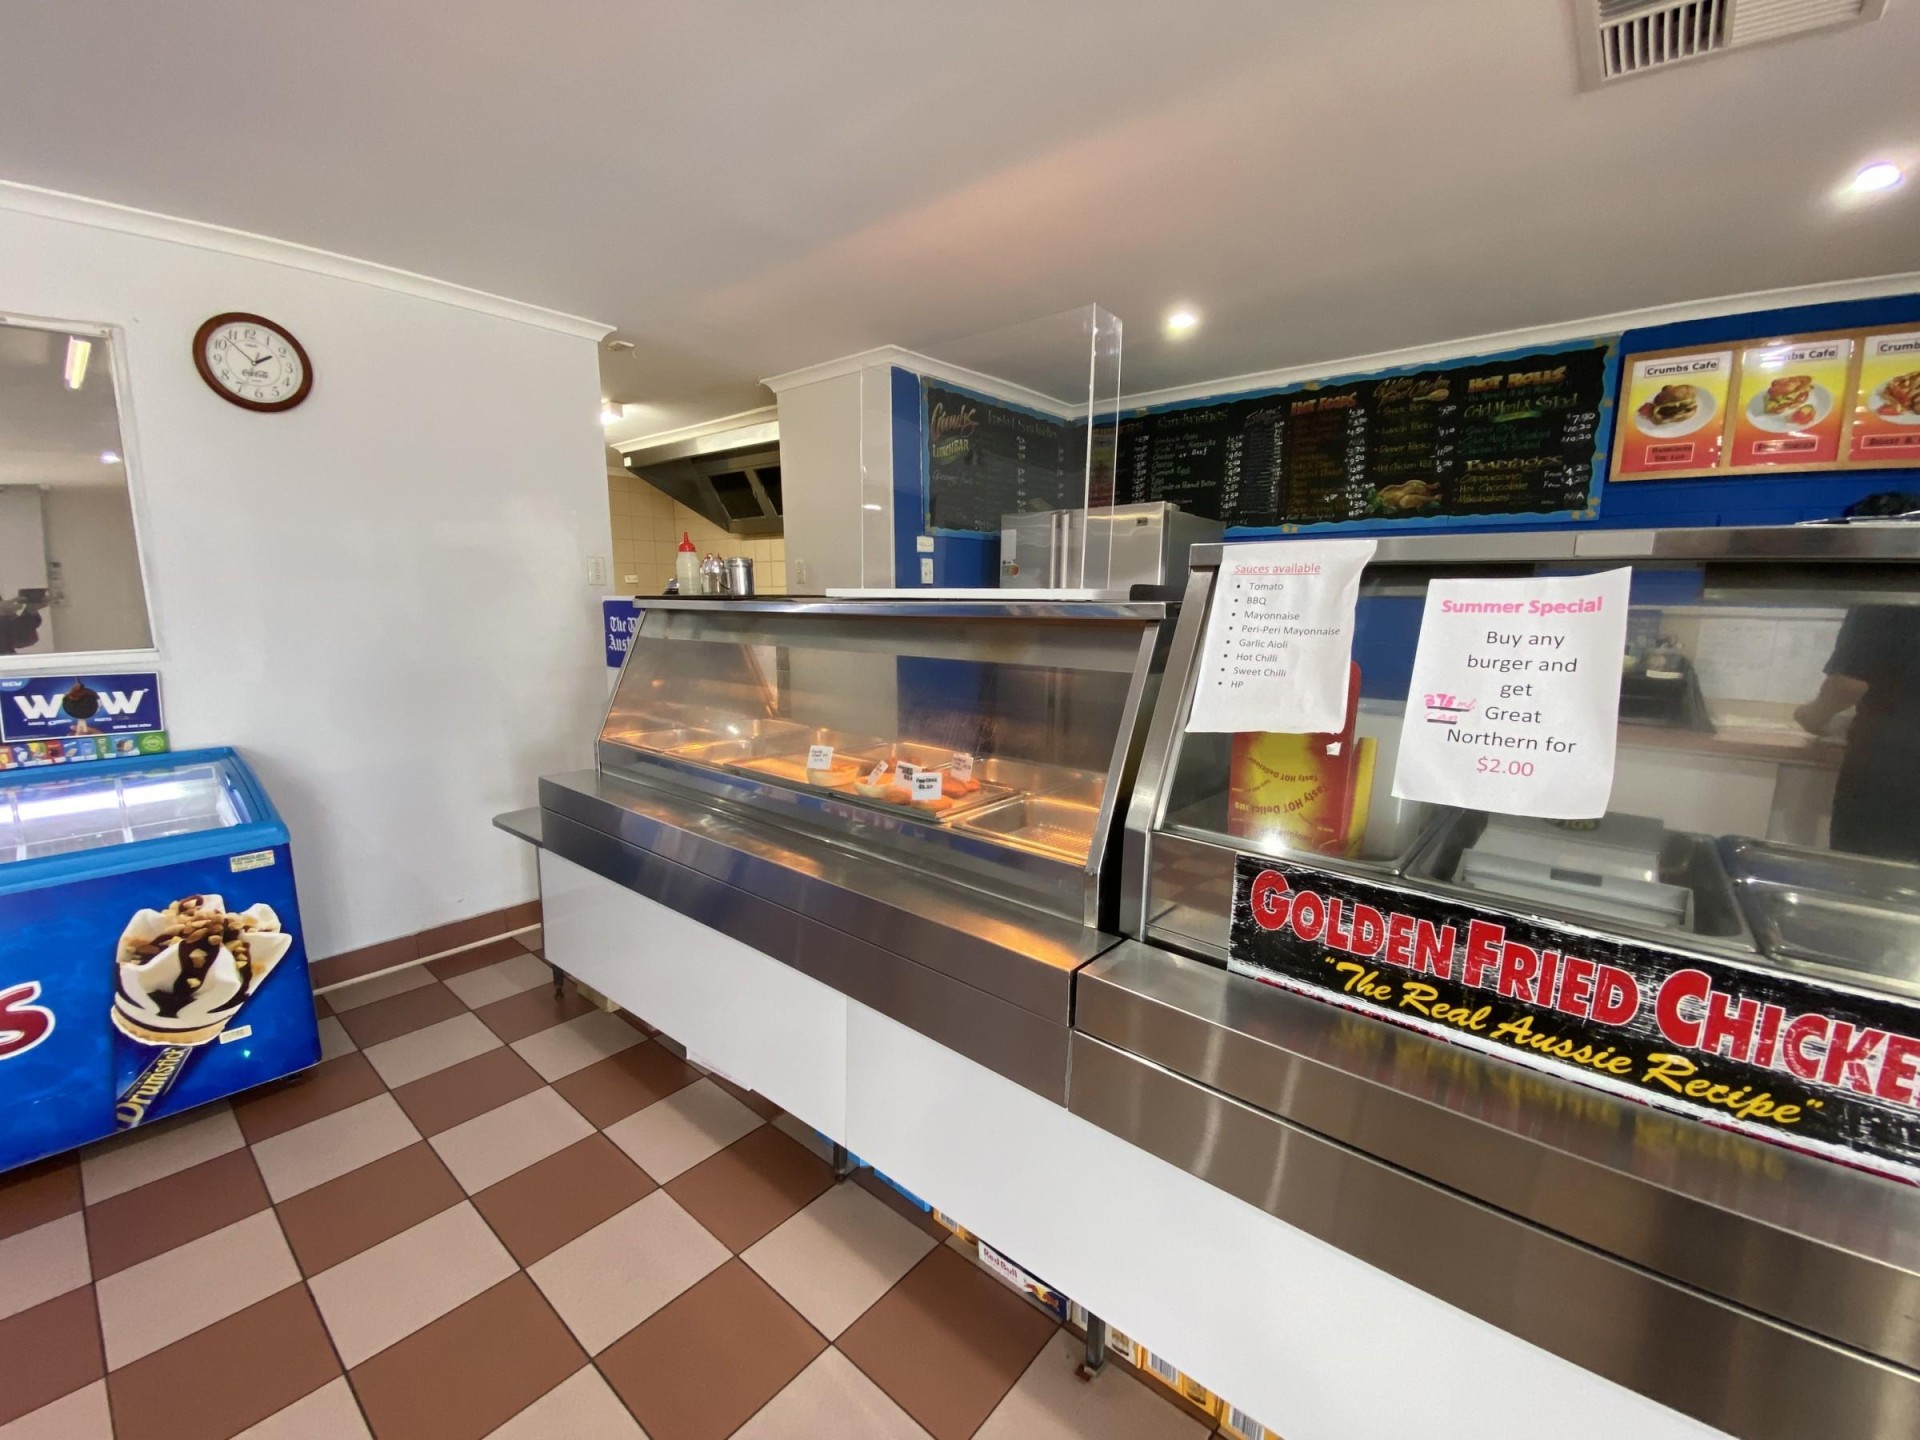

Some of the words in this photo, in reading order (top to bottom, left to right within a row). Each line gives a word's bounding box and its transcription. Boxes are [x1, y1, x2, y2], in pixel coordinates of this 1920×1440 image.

[1809, 349, 1836, 359] Cafe
[1880, 342, 1920, 352] Crumb
[1647, 364, 1689, 376] Crumbs
[1692, 361, 1717, 371] Cafe
[1234, 565, 1270, 574] Sauces
[1273, 564, 1321, 574] available
[1249, 582, 1283, 591] Tomato
[1246, 596, 1266, 606] BBQ
[1441, 600, 1524, 613] Summer
[1528, 596, 1603, 617] Special
[1244, 611, 1300, 621] Mayonnaise
[609, 616, 627, 634] The
[1241, 625, 1281, 634] Peri-Peri
[1283, 627, 1340, 636] Mayonnaise
[1239, 639, 1265, 649] Garlic
[1267, 641, 1288, 649] Aioli
[1486, 631, 1523, 648] Buy
[1529, 634, 1565, 648] any
[1236, 653, 1253, 661] Hot
[1256, 654, 1278, 662] Chilli
[1467, 654, 1532, 672] burger
[1539, 658, 1578, 672] and
[1234, 667, 1261, 676] Sweet
[1264, 669, 1286, 677] Chilli
[1230, 680, 1244, 688] HP
[1500, 682, 1533, 698] get
[1485, 707, 1542, 724] Great
[1447, 728, 1538, 750] Northern
[1546, 737, 1577, 754] for
[1476, 756, 1534, 776] $2.00
[1280, 774, 1296, 782] HOT
[1283, 798, 1304, 814] HOT
[1250, 869, 1457, 980] GOLDEN
[1462, 918, 1639, 1026] FRIED
[1655, 968, 1920, 1108] CHICKE
[1399, 980, 1488, 1031] Real
[1490, 1014, 1633, 1074] Aussie
[116, 1048, 187, 1124] Drumstick
